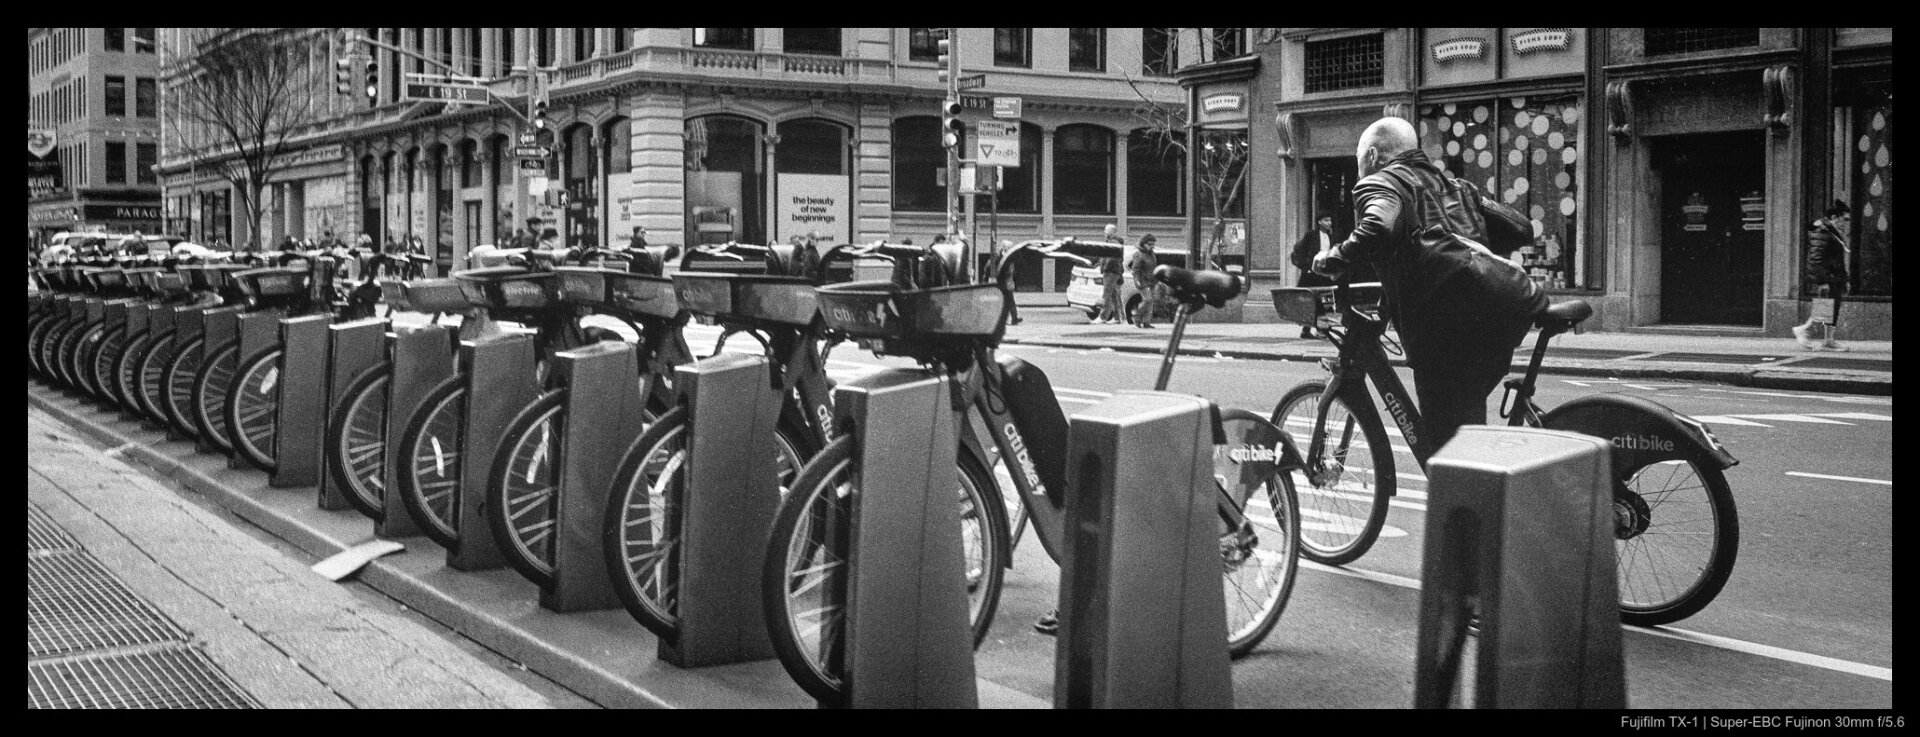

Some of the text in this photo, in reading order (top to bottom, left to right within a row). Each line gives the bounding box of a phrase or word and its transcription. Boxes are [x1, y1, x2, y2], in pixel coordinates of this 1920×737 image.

[441, 87, 452, 98] 19
[456, 88, 467, 100] St
[793, 196, 834, 206] the beauty
[800, 205, 808, 213] of
[791, 213, 835, 224] beginnings
